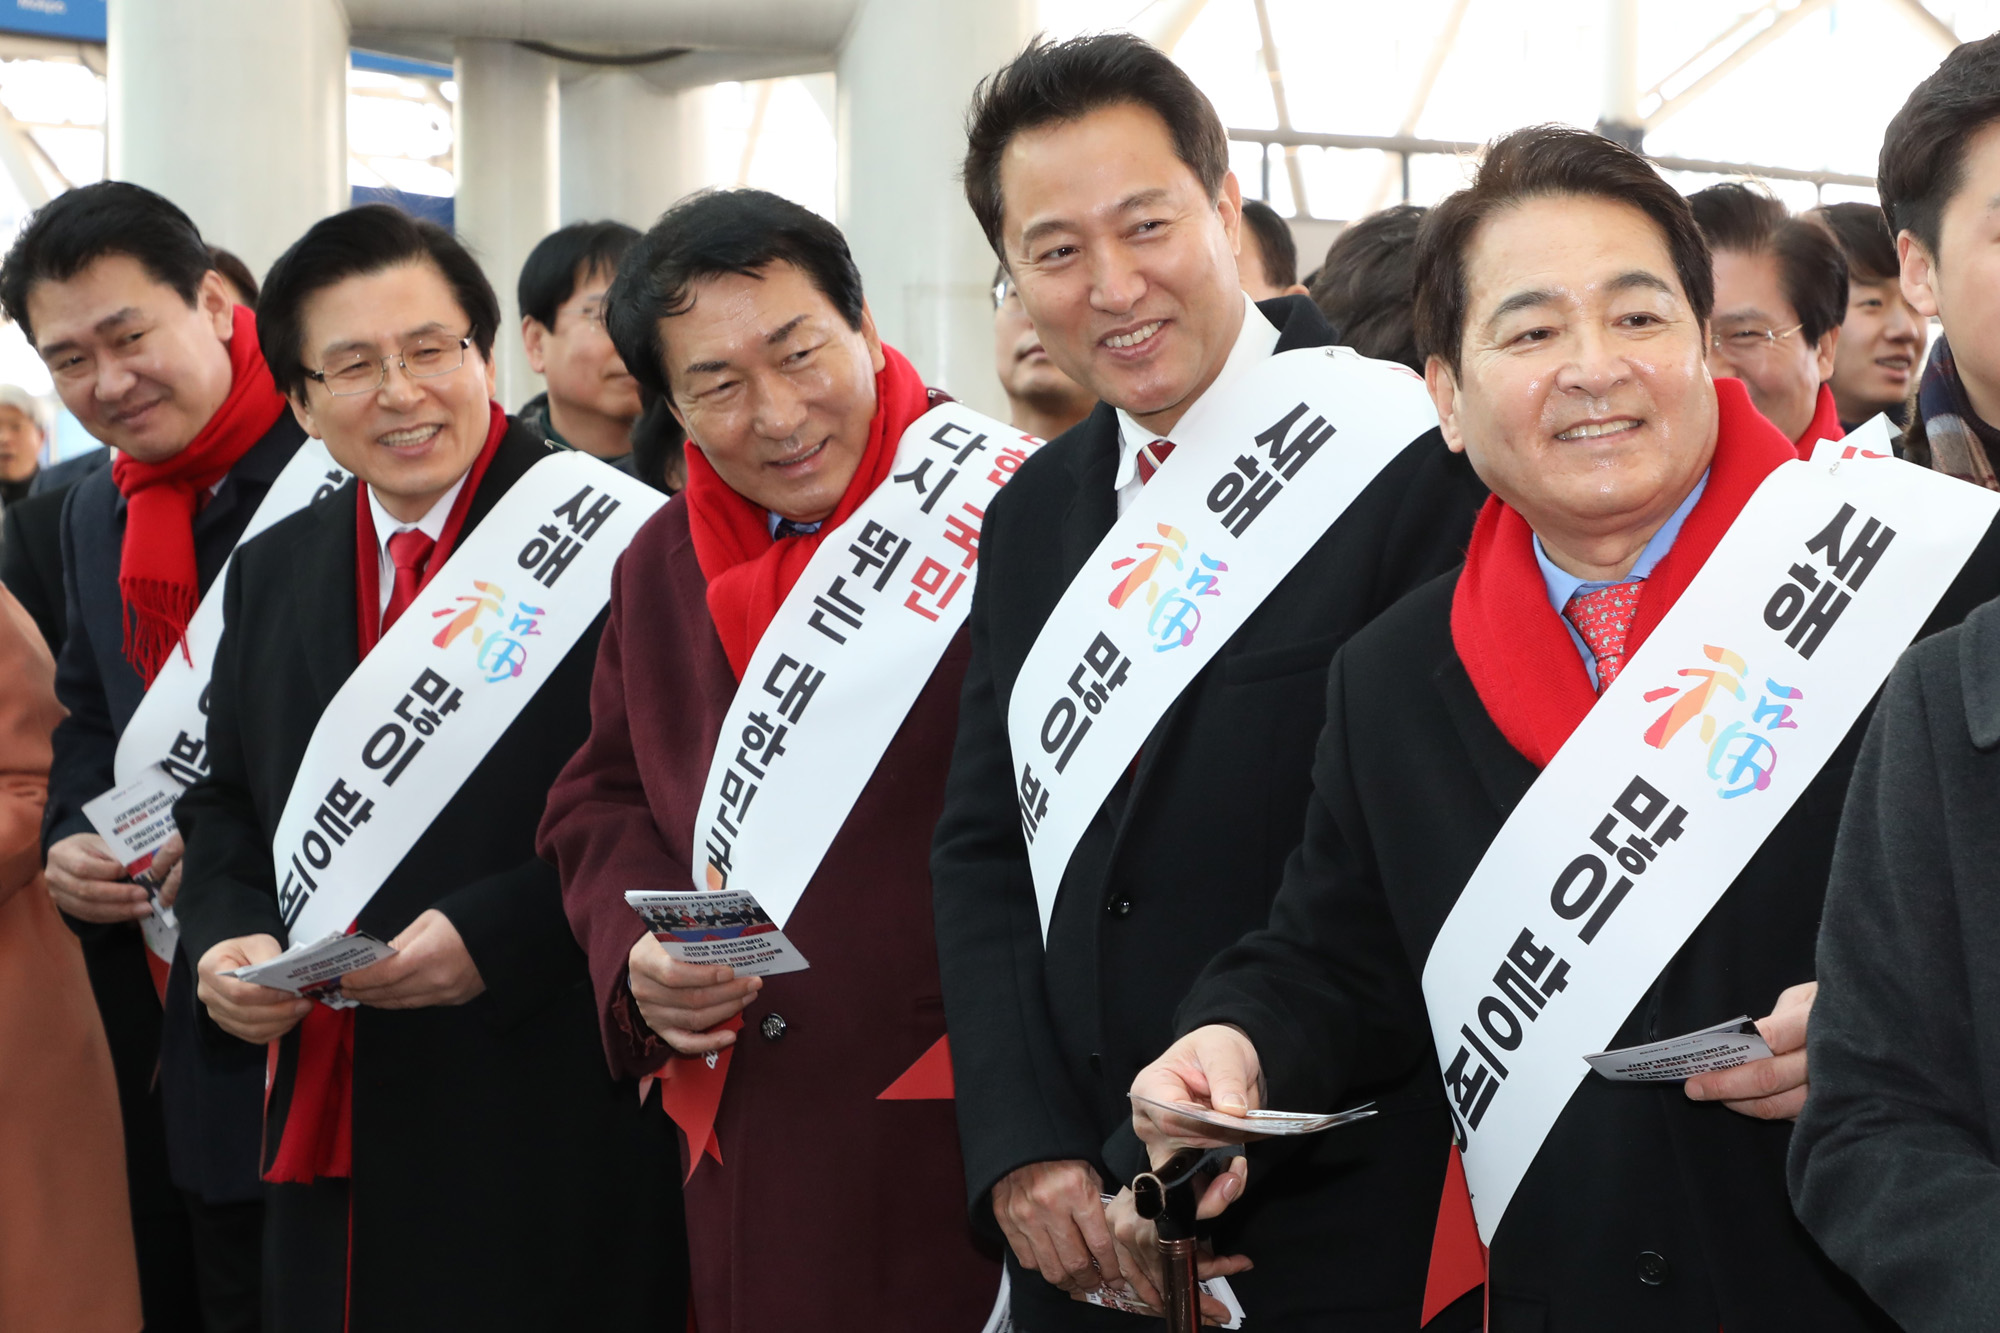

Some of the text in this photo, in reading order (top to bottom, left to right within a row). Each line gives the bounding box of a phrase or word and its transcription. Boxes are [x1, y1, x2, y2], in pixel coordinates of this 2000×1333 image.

[518, 485, 621, 589] 새해
[1206, 401, 1337, 539] 새해
[1763, 502, 1897, 661] 새해
[361, 667, 464, 788] 많이
[705, 422, 988, 890] 다시 뛰는 대한민국
[1040, 631, 1132, 774] 많이
[1550, 775, 1689, 946] 많이
